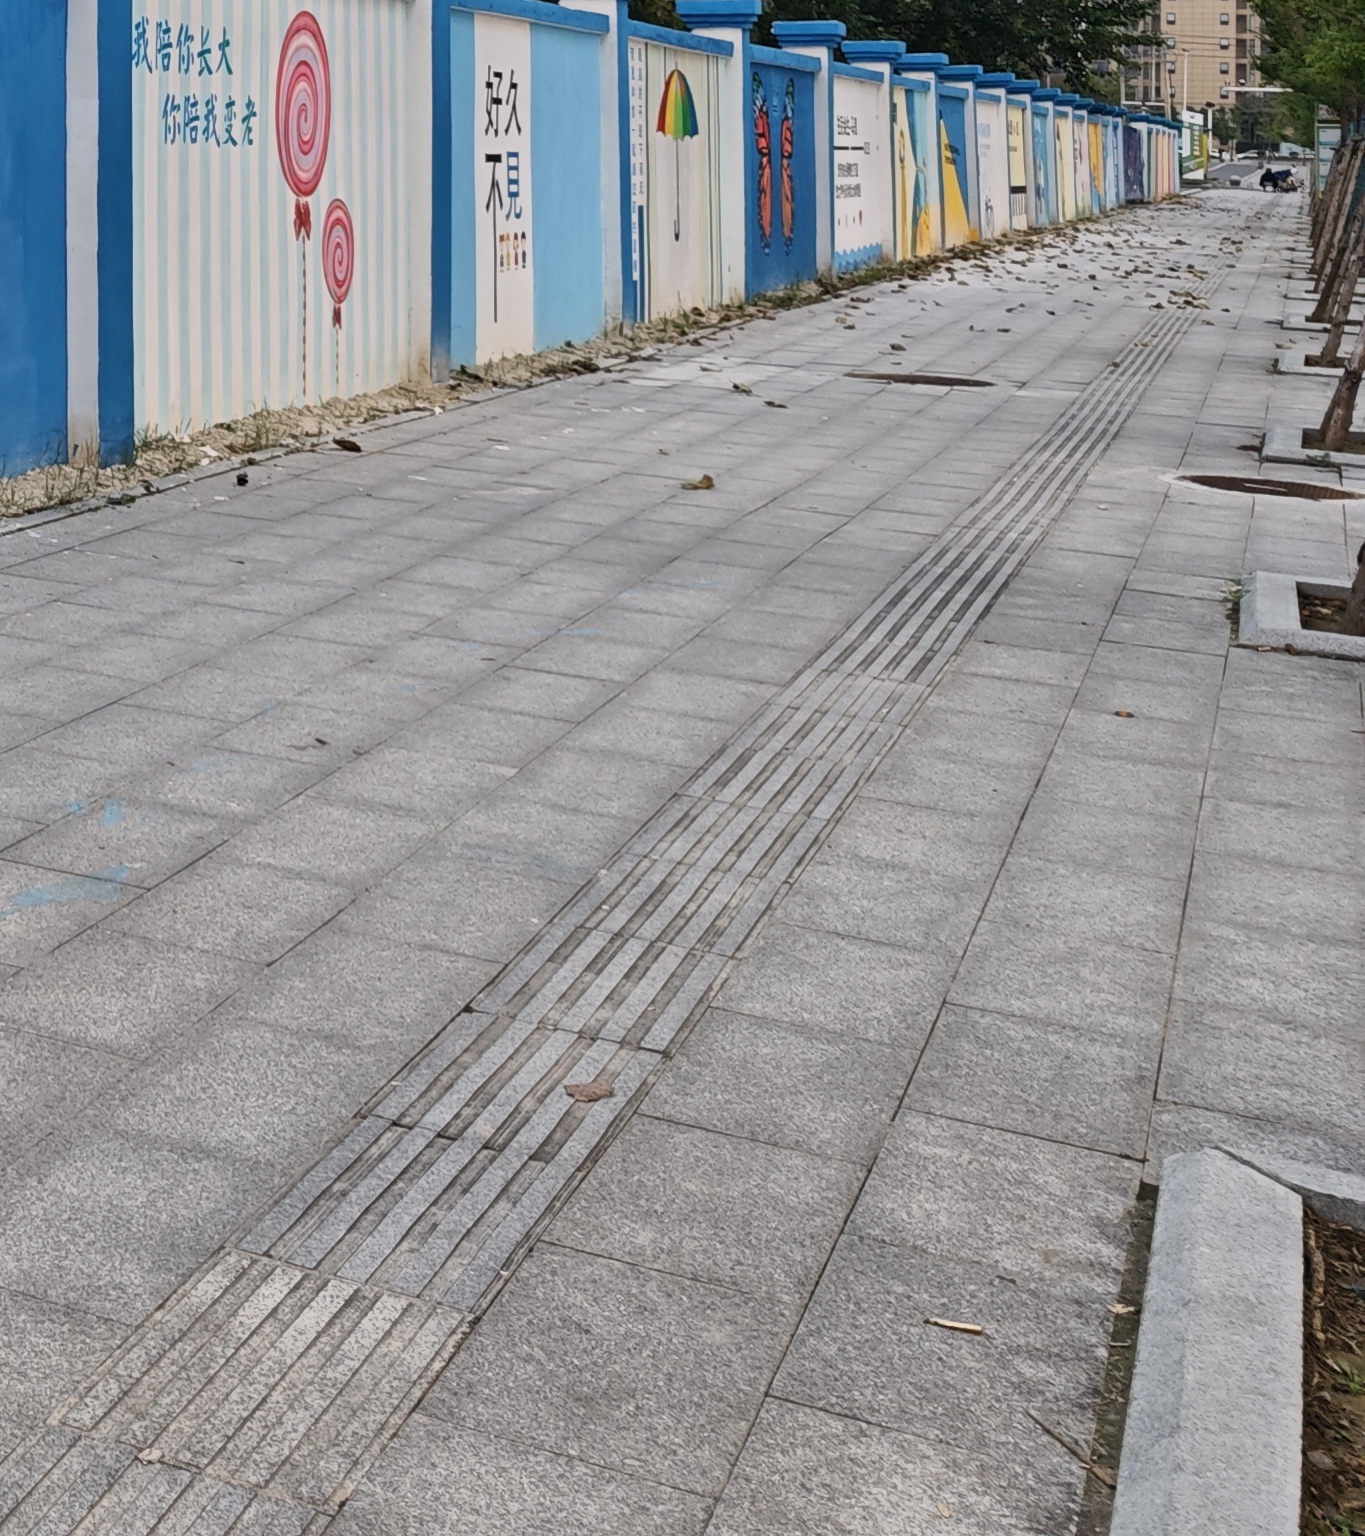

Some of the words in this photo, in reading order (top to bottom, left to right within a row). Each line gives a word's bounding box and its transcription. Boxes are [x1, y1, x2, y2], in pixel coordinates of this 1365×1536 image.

[132, 15, 234, 77] 我陪你长大
[161, 93, 258, 148] 你陪我变老
[484, 64, 522, 138] 好久
